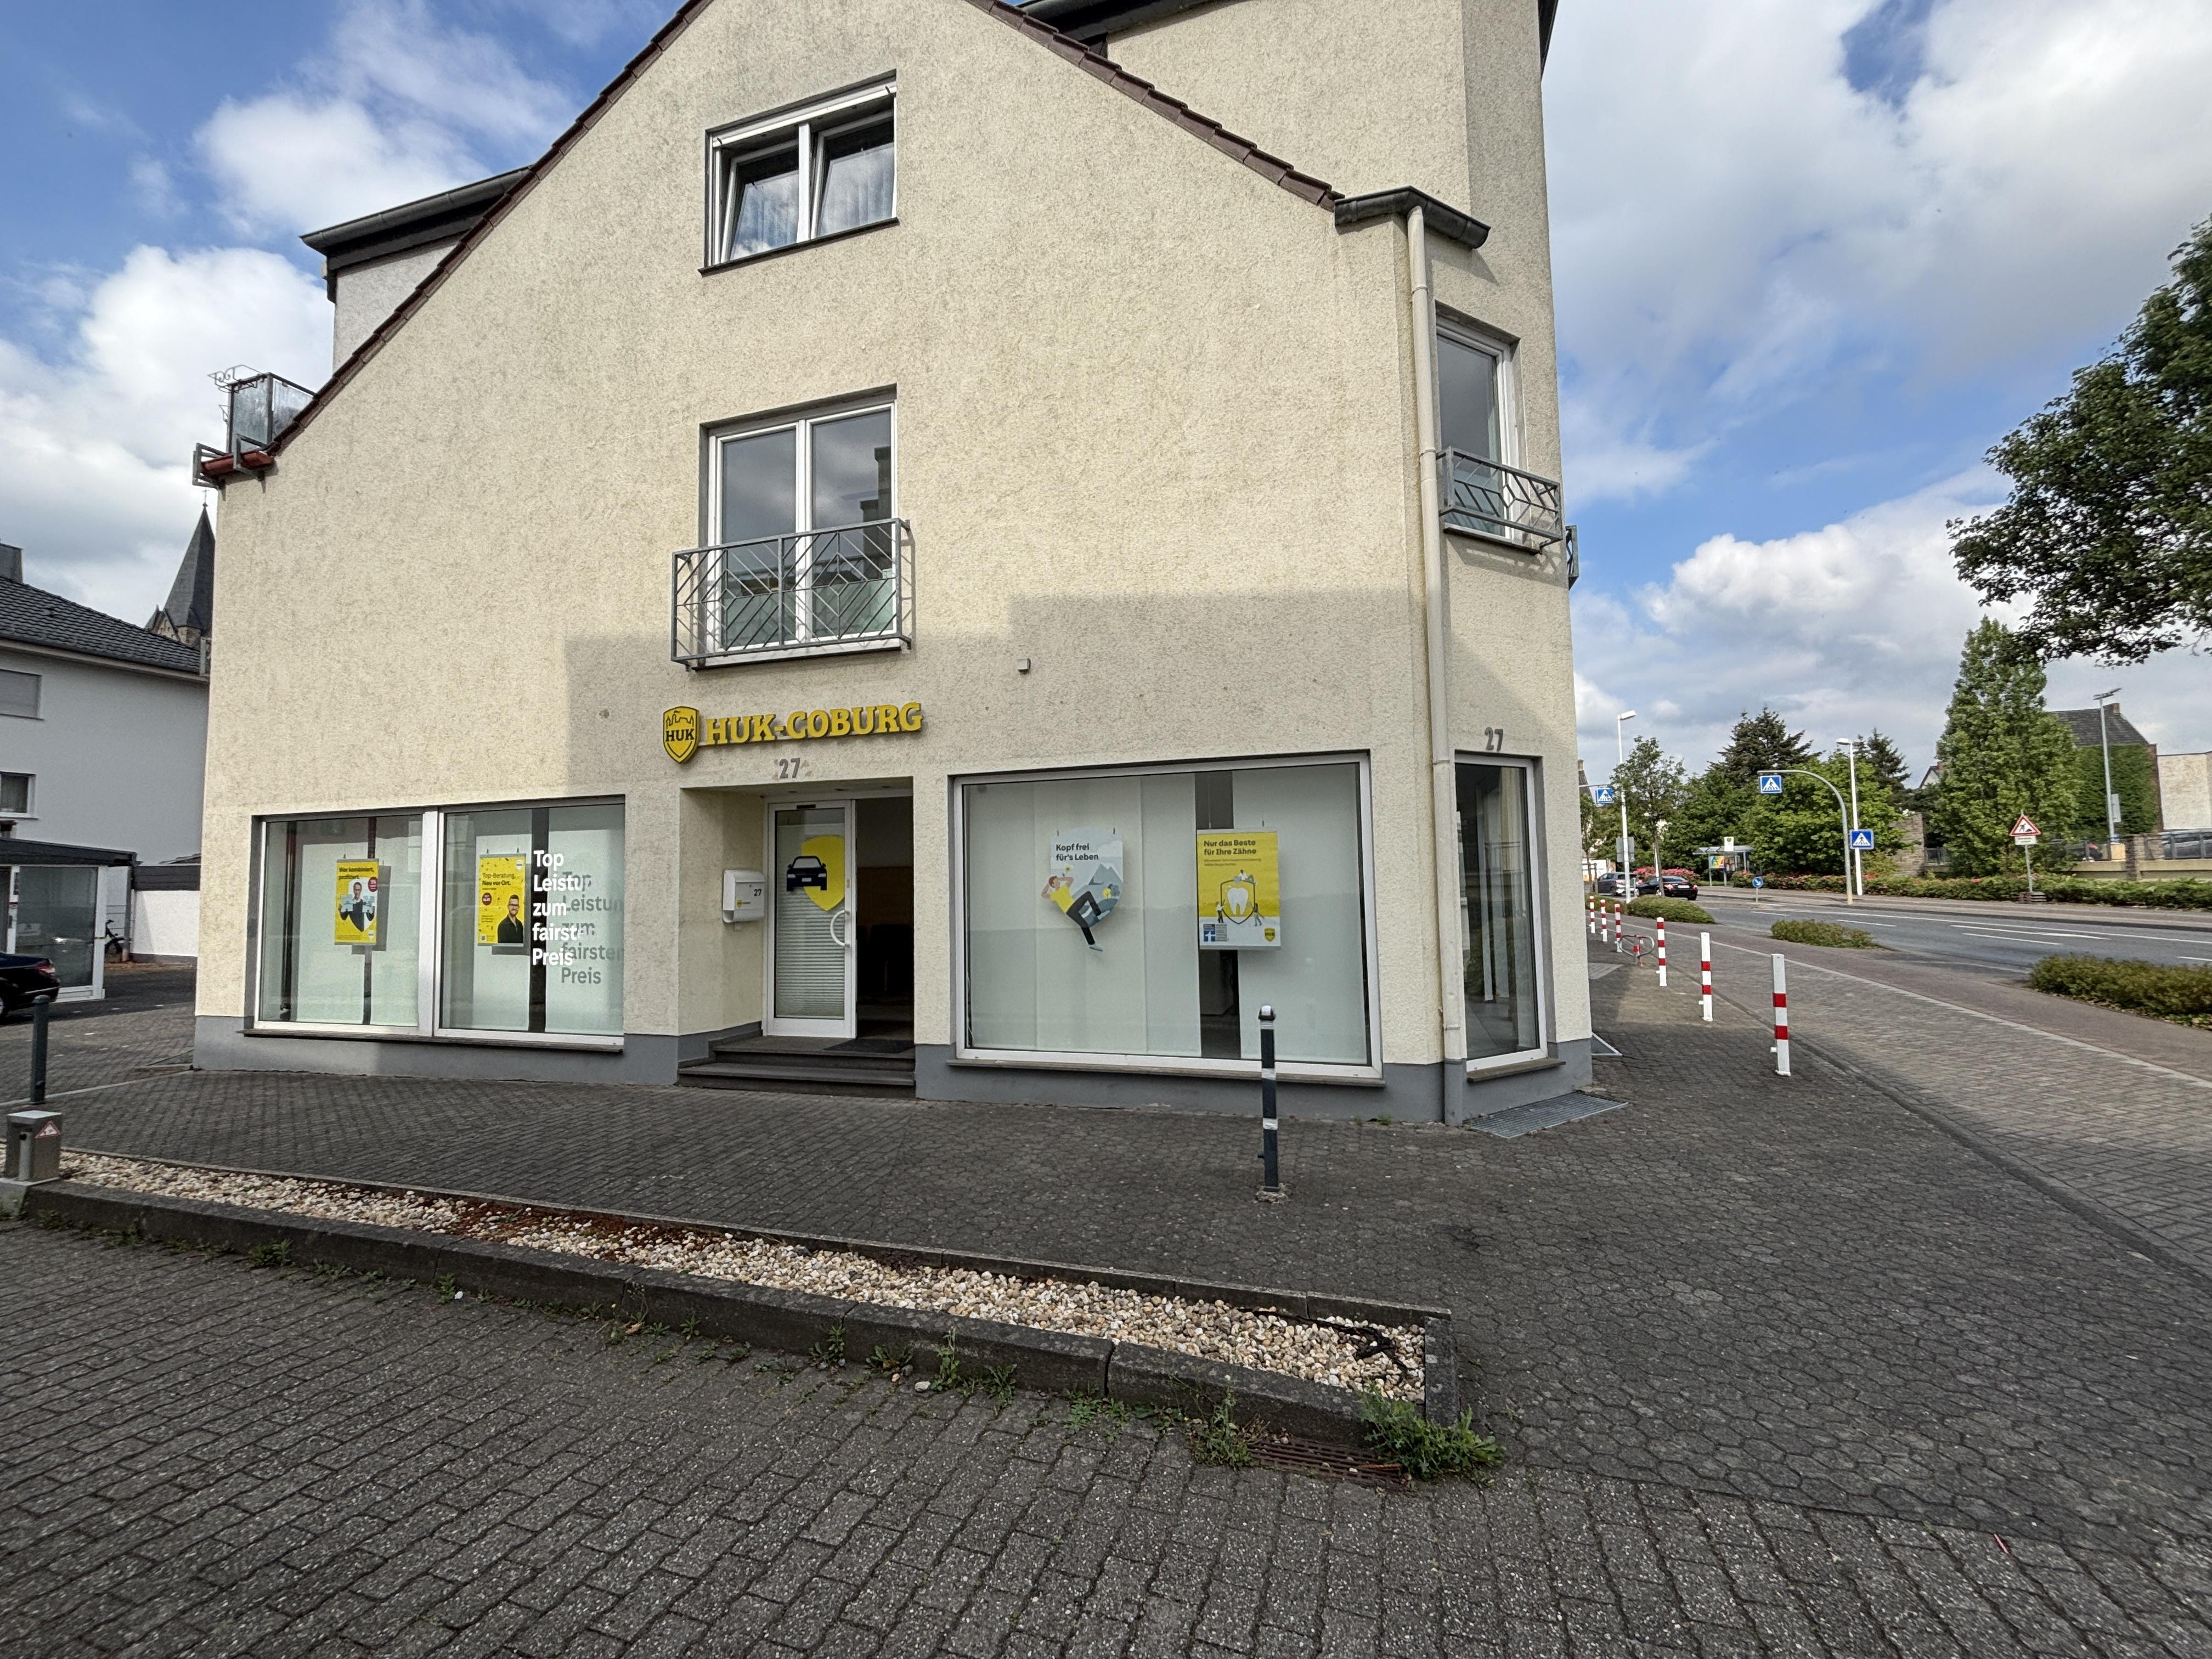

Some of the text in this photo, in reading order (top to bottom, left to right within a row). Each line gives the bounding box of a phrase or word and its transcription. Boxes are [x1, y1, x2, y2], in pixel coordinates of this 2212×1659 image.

[706, 702, 924, 746] HUK-COBURG
[665, 728, 695, 742] HUK
[1485, 727, 1504, 752] 27
[778, 758, 801, 780] 27
[1056, 843, 1075, 853] Kopf
[534, 850, 564, 871] Top
[533, 902, 567, 916] zum
[532, 947, 573, 966] Preis
